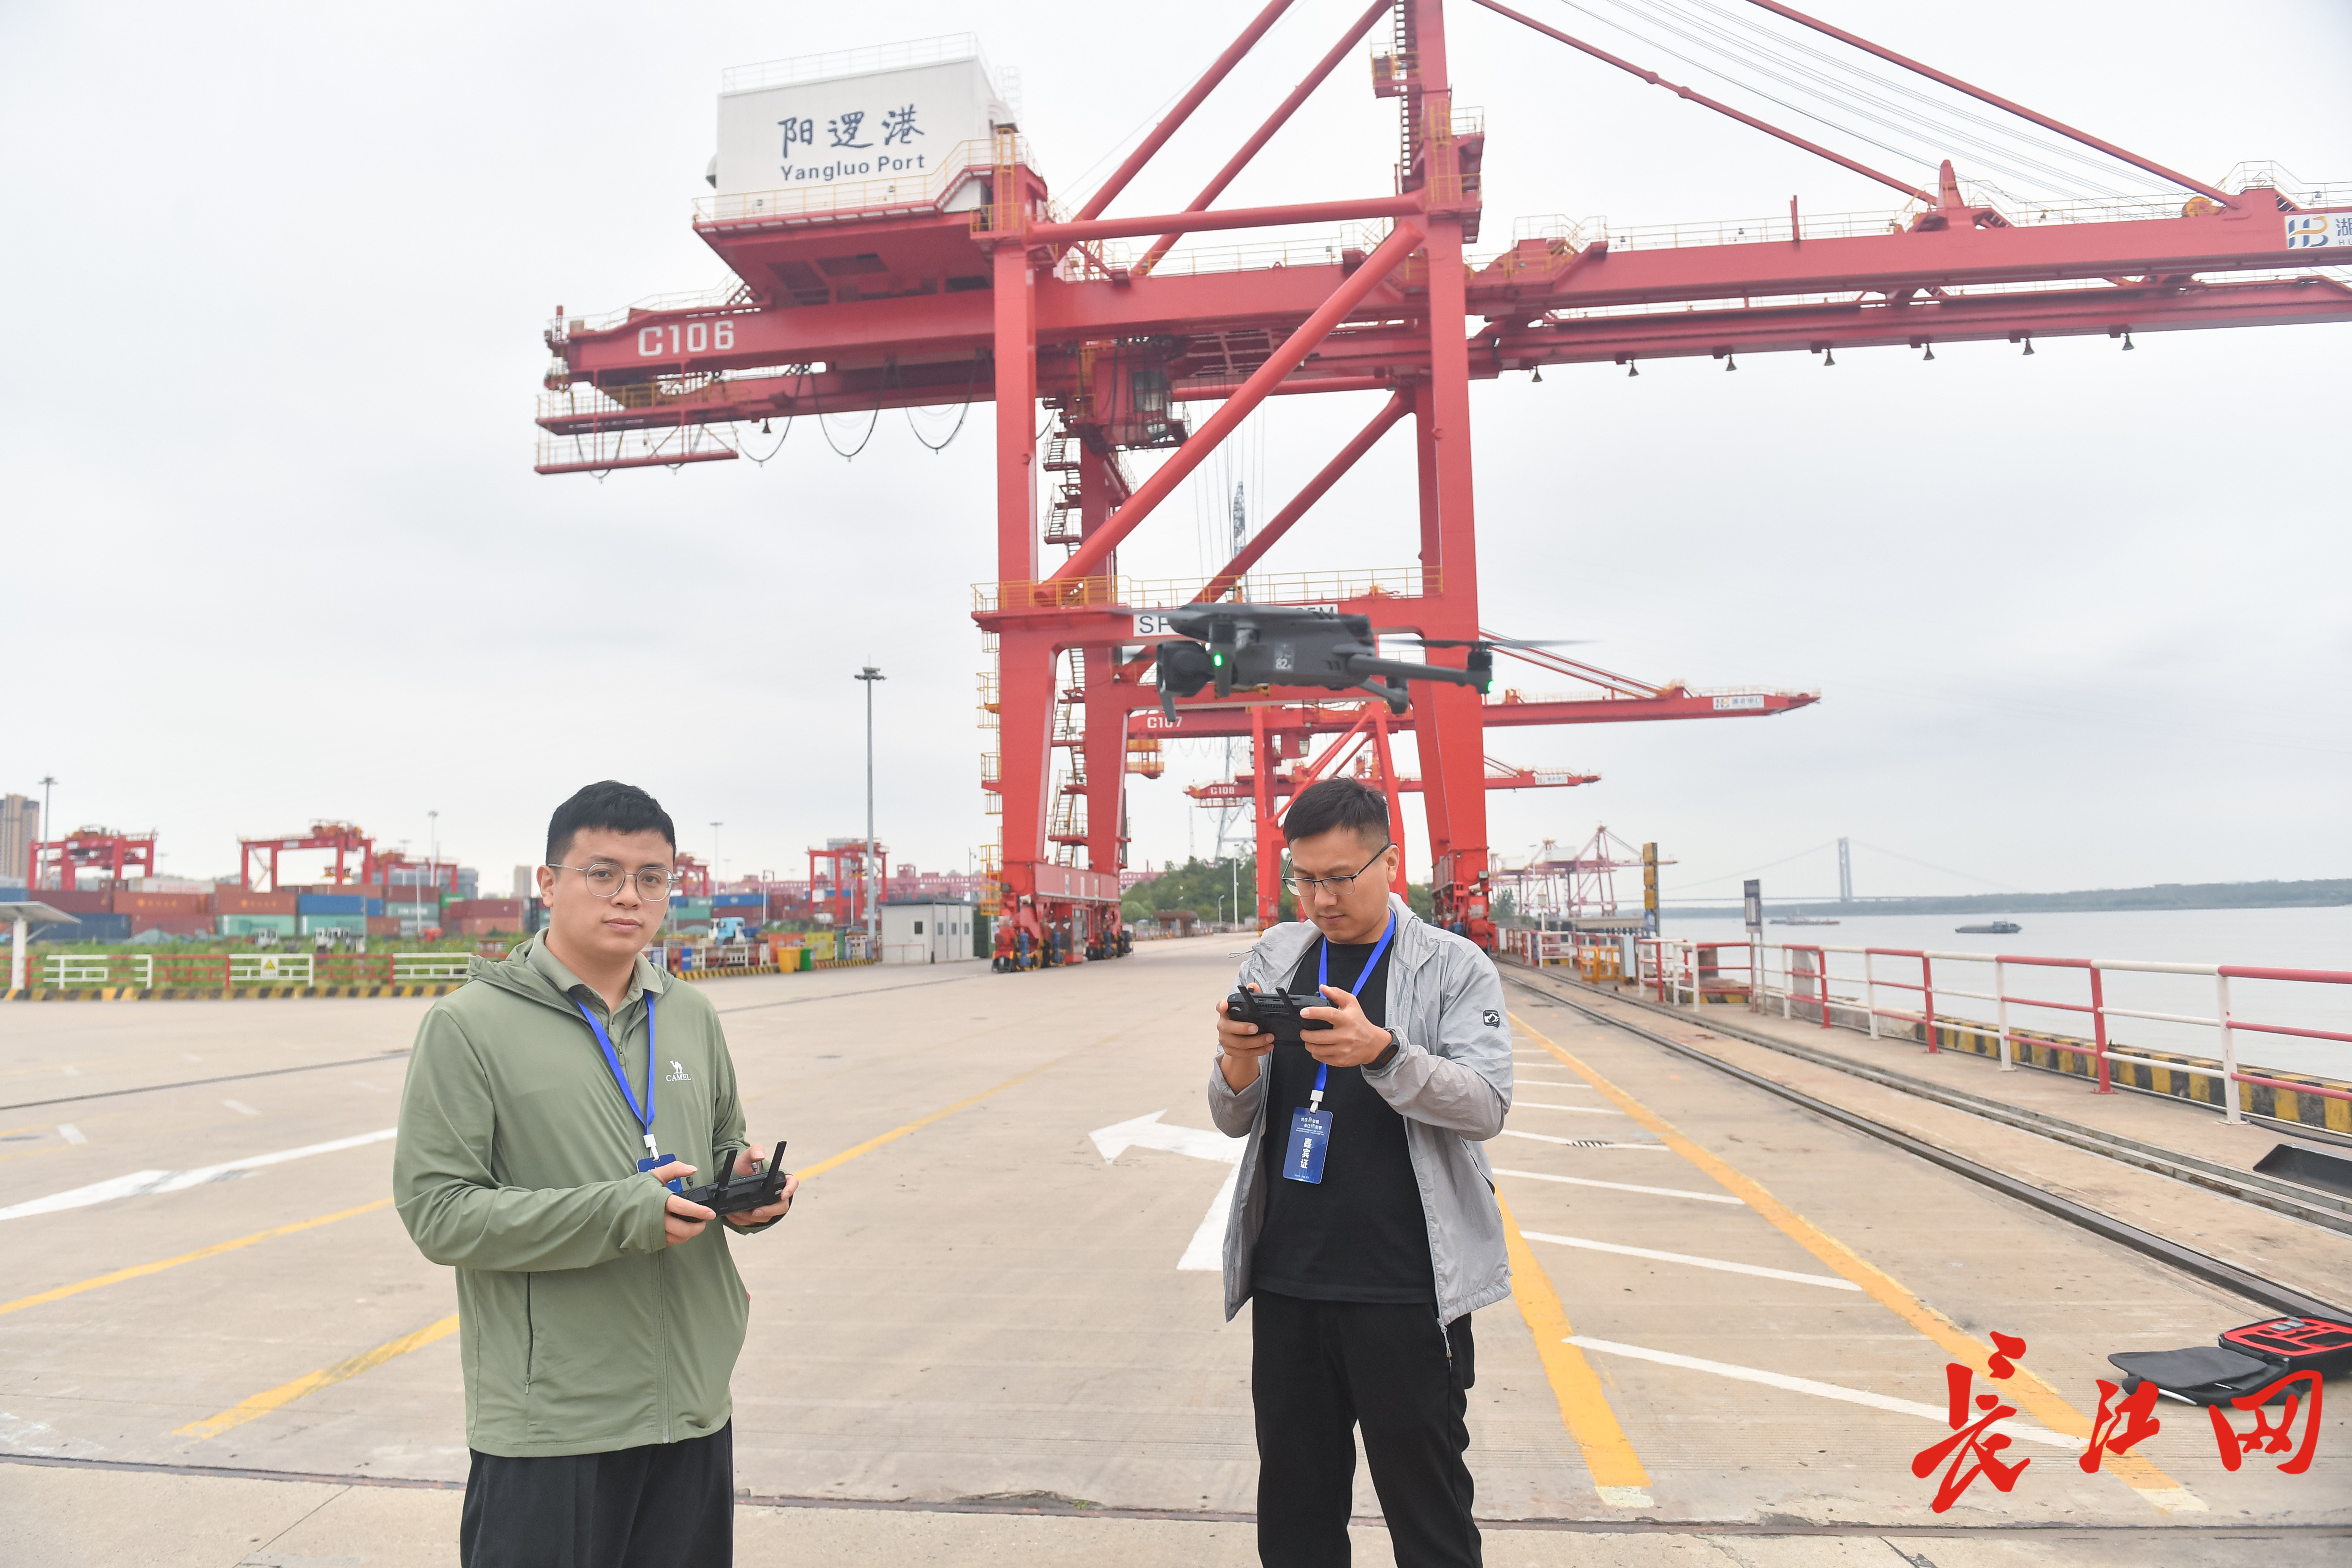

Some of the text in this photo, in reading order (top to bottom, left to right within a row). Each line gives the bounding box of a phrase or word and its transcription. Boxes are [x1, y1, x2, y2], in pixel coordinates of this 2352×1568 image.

[778, 104, 924, 158] 阳逻港
[781, 154, 924, 181] Yangluo Port
[638, 320, 734, 357] C106
[1147, 716, 1182, 728] C107
[666, 1074, 691, 1082] CAMEL
[1300, 1138, 1312, 1169] 嘉宾证
